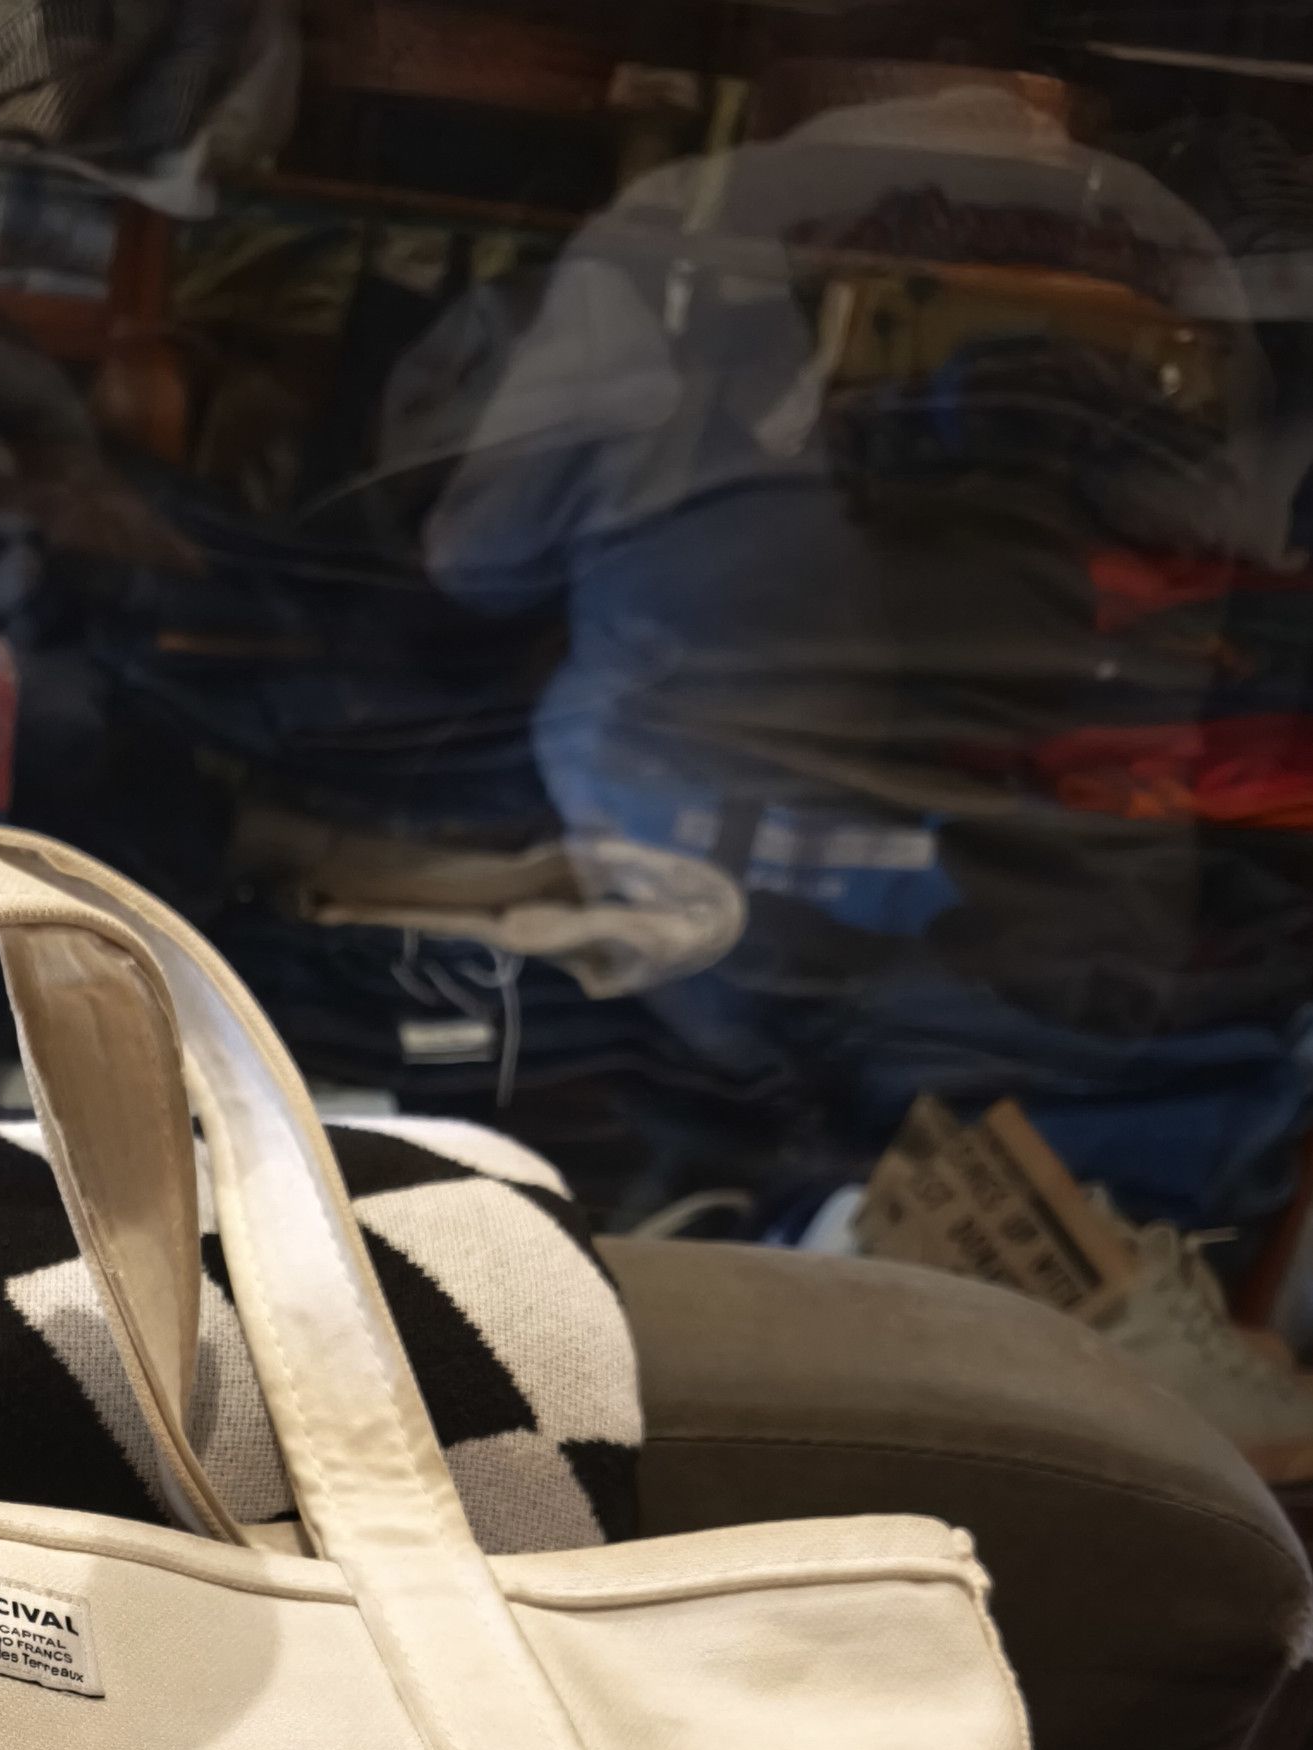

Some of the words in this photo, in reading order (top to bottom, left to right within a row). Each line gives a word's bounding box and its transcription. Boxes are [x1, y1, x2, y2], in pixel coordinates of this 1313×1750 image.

[0, 1624, 67, 1650] CAPITAL
[17, 1639, 73, 1664] FRANCS
[22, 1653, 84, 1683] Terreaux
